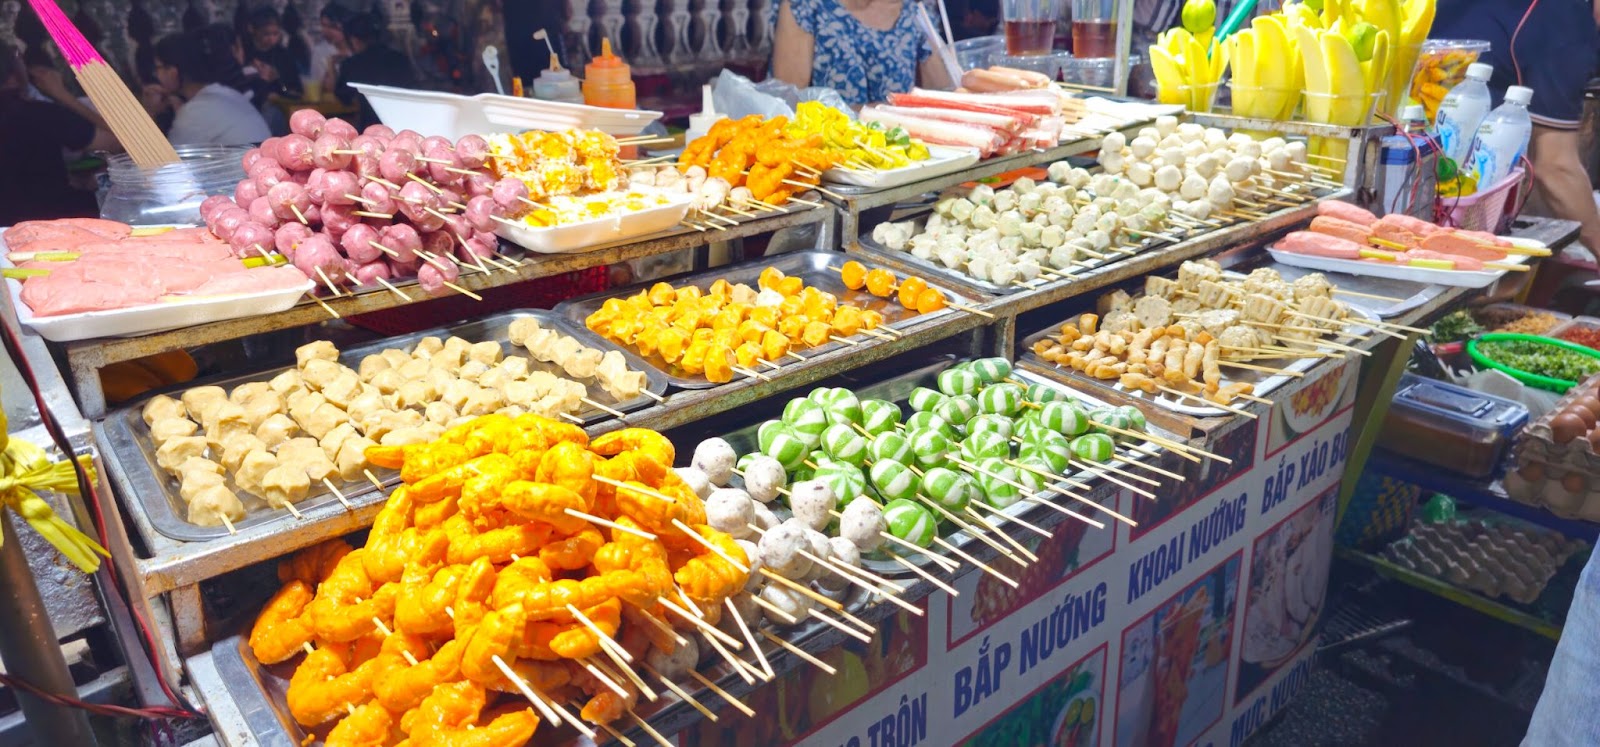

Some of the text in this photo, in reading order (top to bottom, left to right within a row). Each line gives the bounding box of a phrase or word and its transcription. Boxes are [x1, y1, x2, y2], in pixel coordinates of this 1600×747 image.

[1261, 454, 1295, 514] BẮP
[1127, 492, 1247, 604] KHOAI NƯỚNG
[954, 582, 1107, 718] BẮP NƯỚNG
